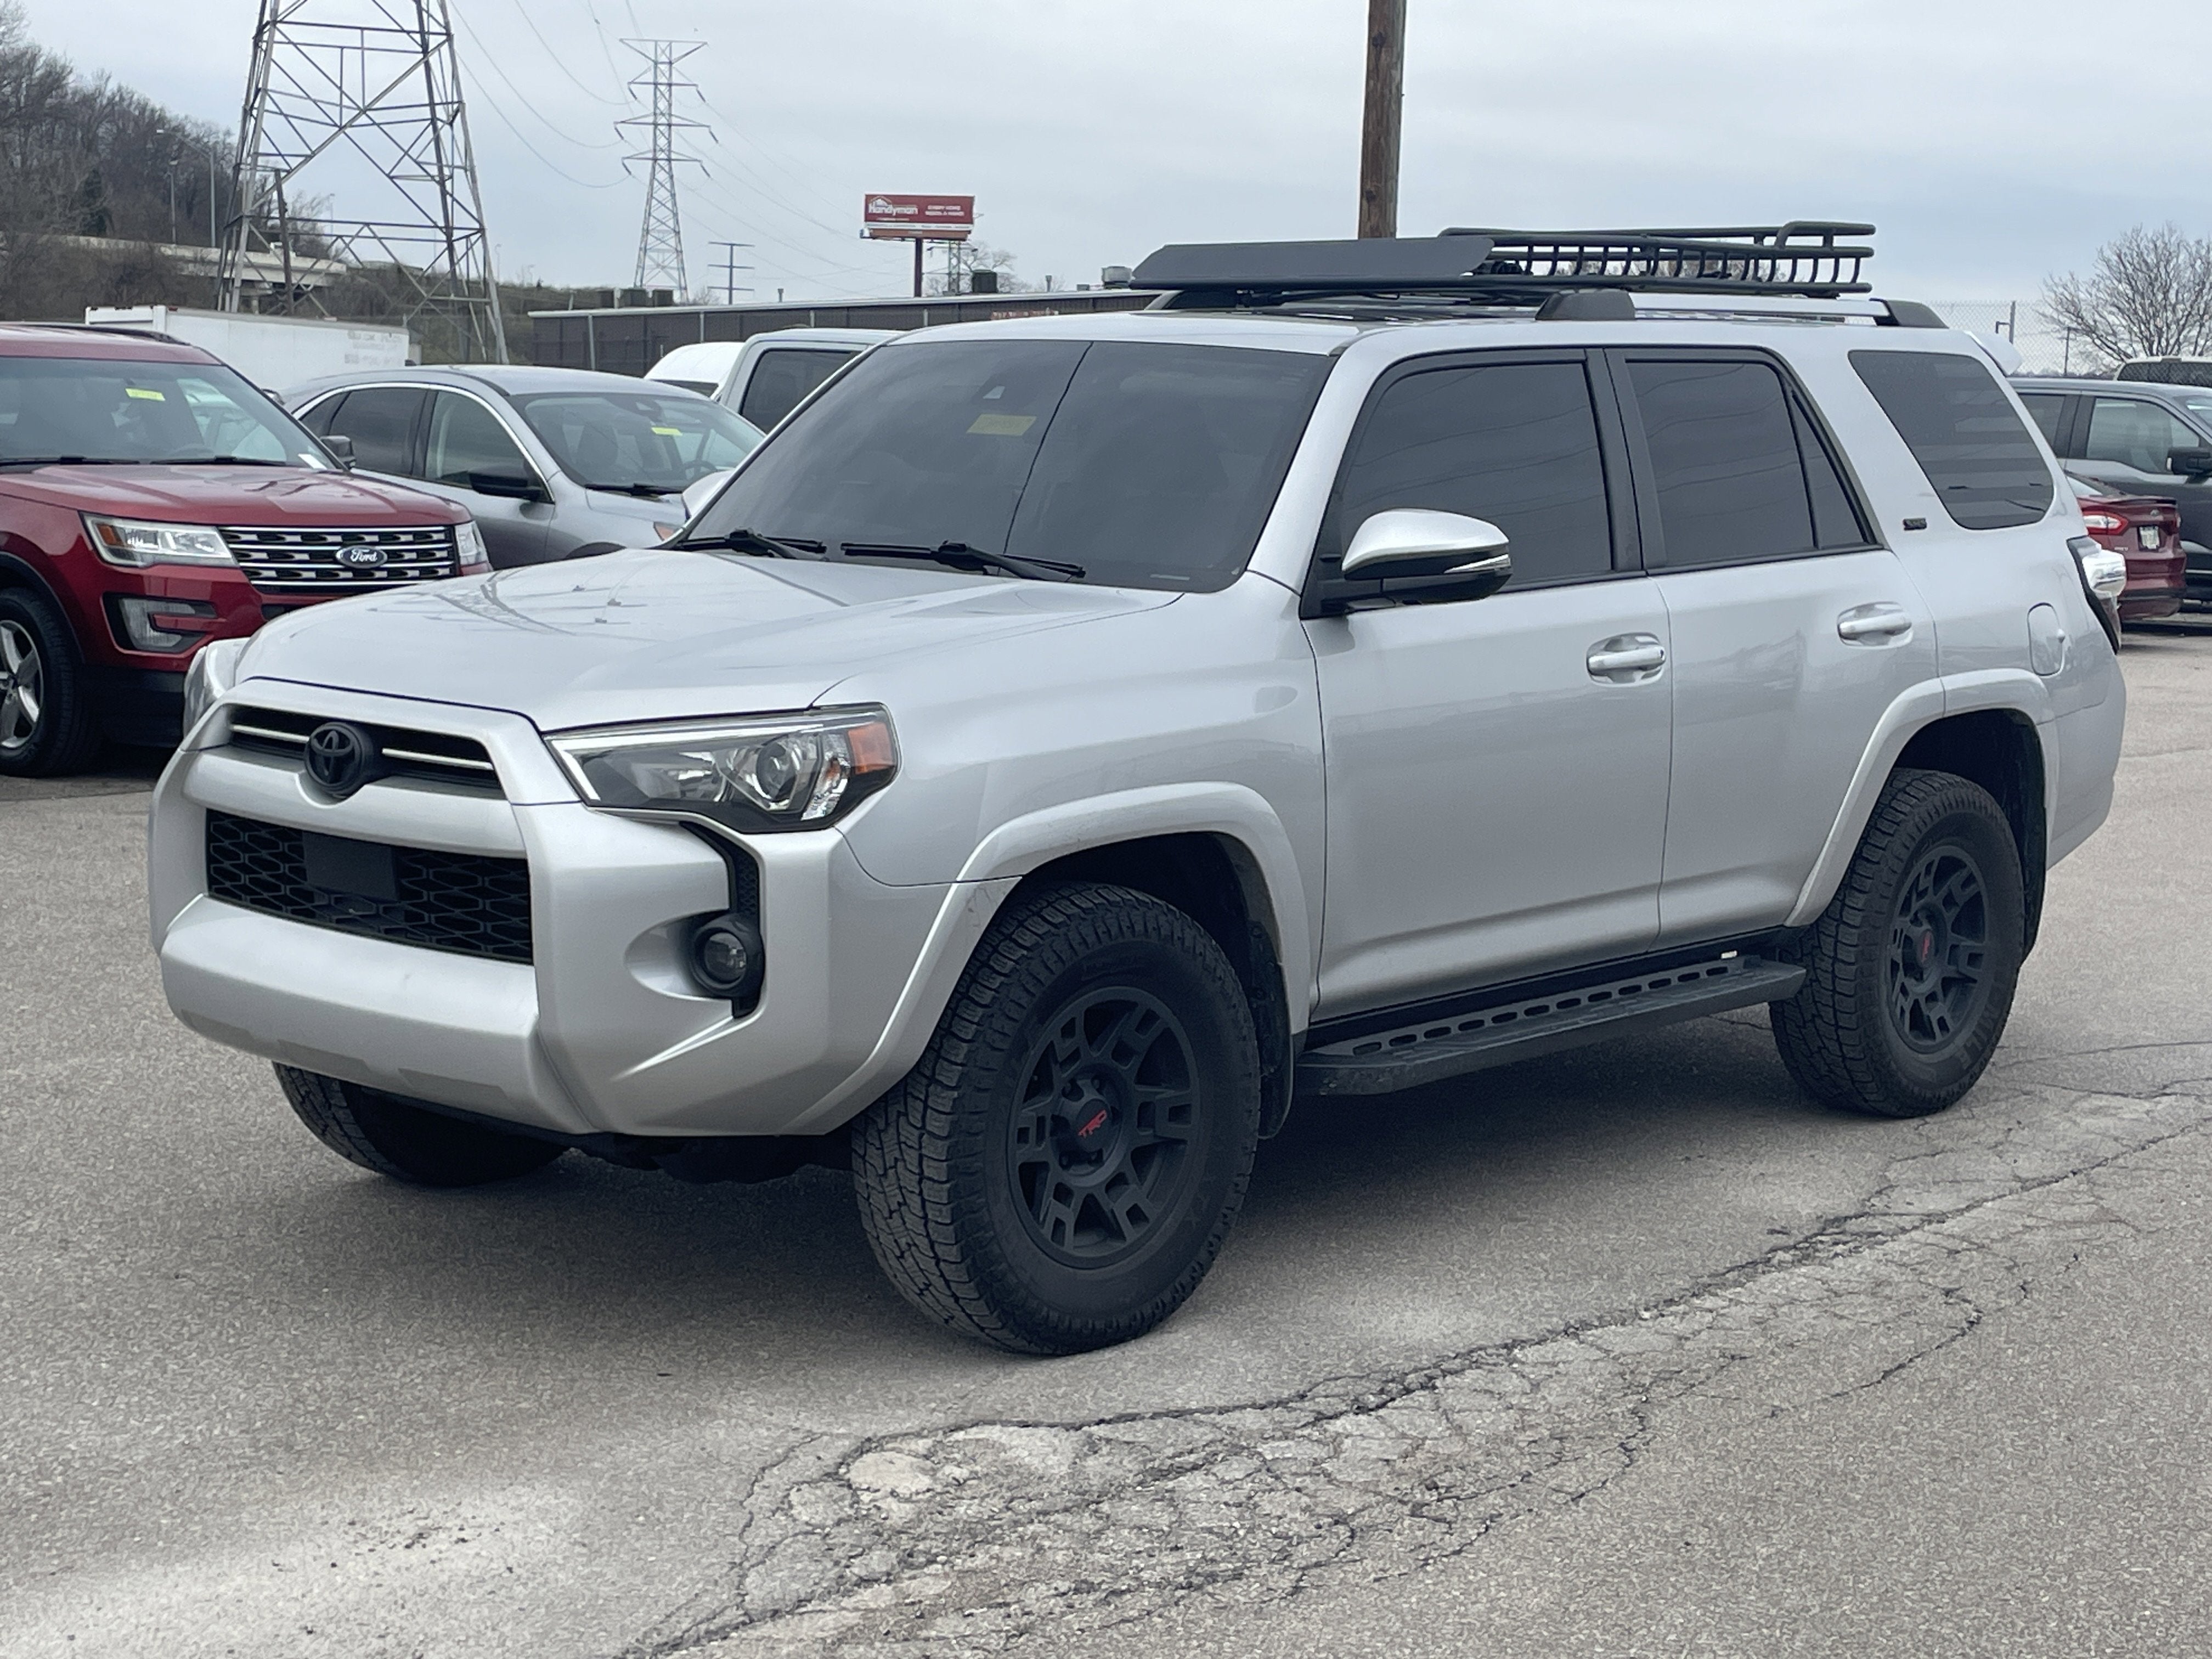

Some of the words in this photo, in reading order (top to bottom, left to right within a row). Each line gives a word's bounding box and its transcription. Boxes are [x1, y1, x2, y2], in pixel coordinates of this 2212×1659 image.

[868, 201, 918, 216] Handyman
[351, 548, 377, 562] Ford
[1077, 1109, 1107, 1138] TRD
